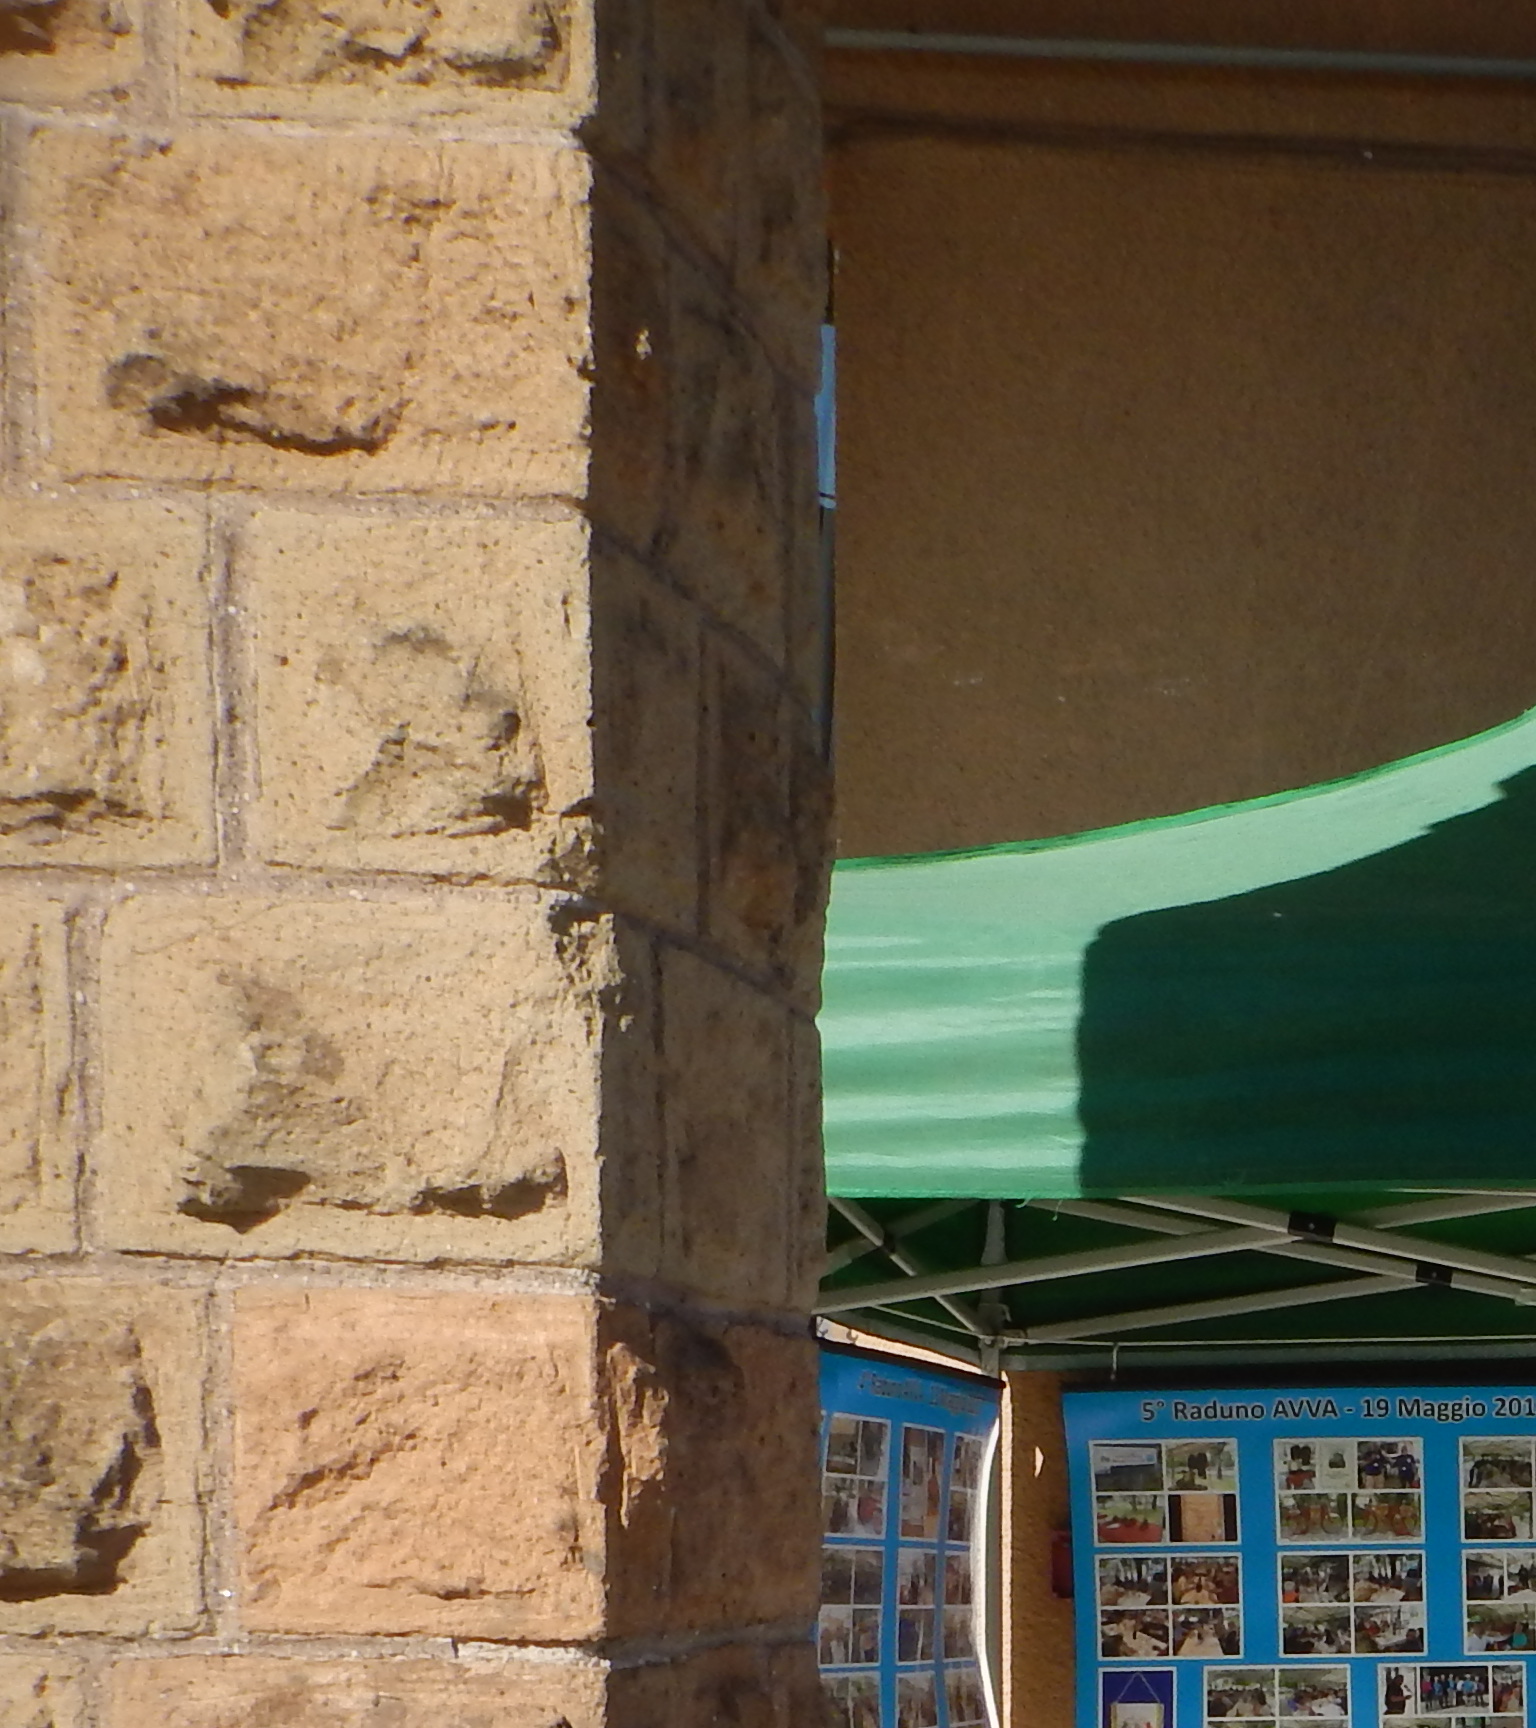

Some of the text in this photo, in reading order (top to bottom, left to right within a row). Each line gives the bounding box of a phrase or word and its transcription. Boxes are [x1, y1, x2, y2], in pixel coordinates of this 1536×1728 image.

[1142, 1401, 1165, 1420] 5°
[1174, 1401, 1264, 1420] Raduno
[1273, 1400, 1338, 1418] AVVA
[1362, 1399, 1390, 1418] 19
[1399, 1399, 1486, 1421] Maggio
